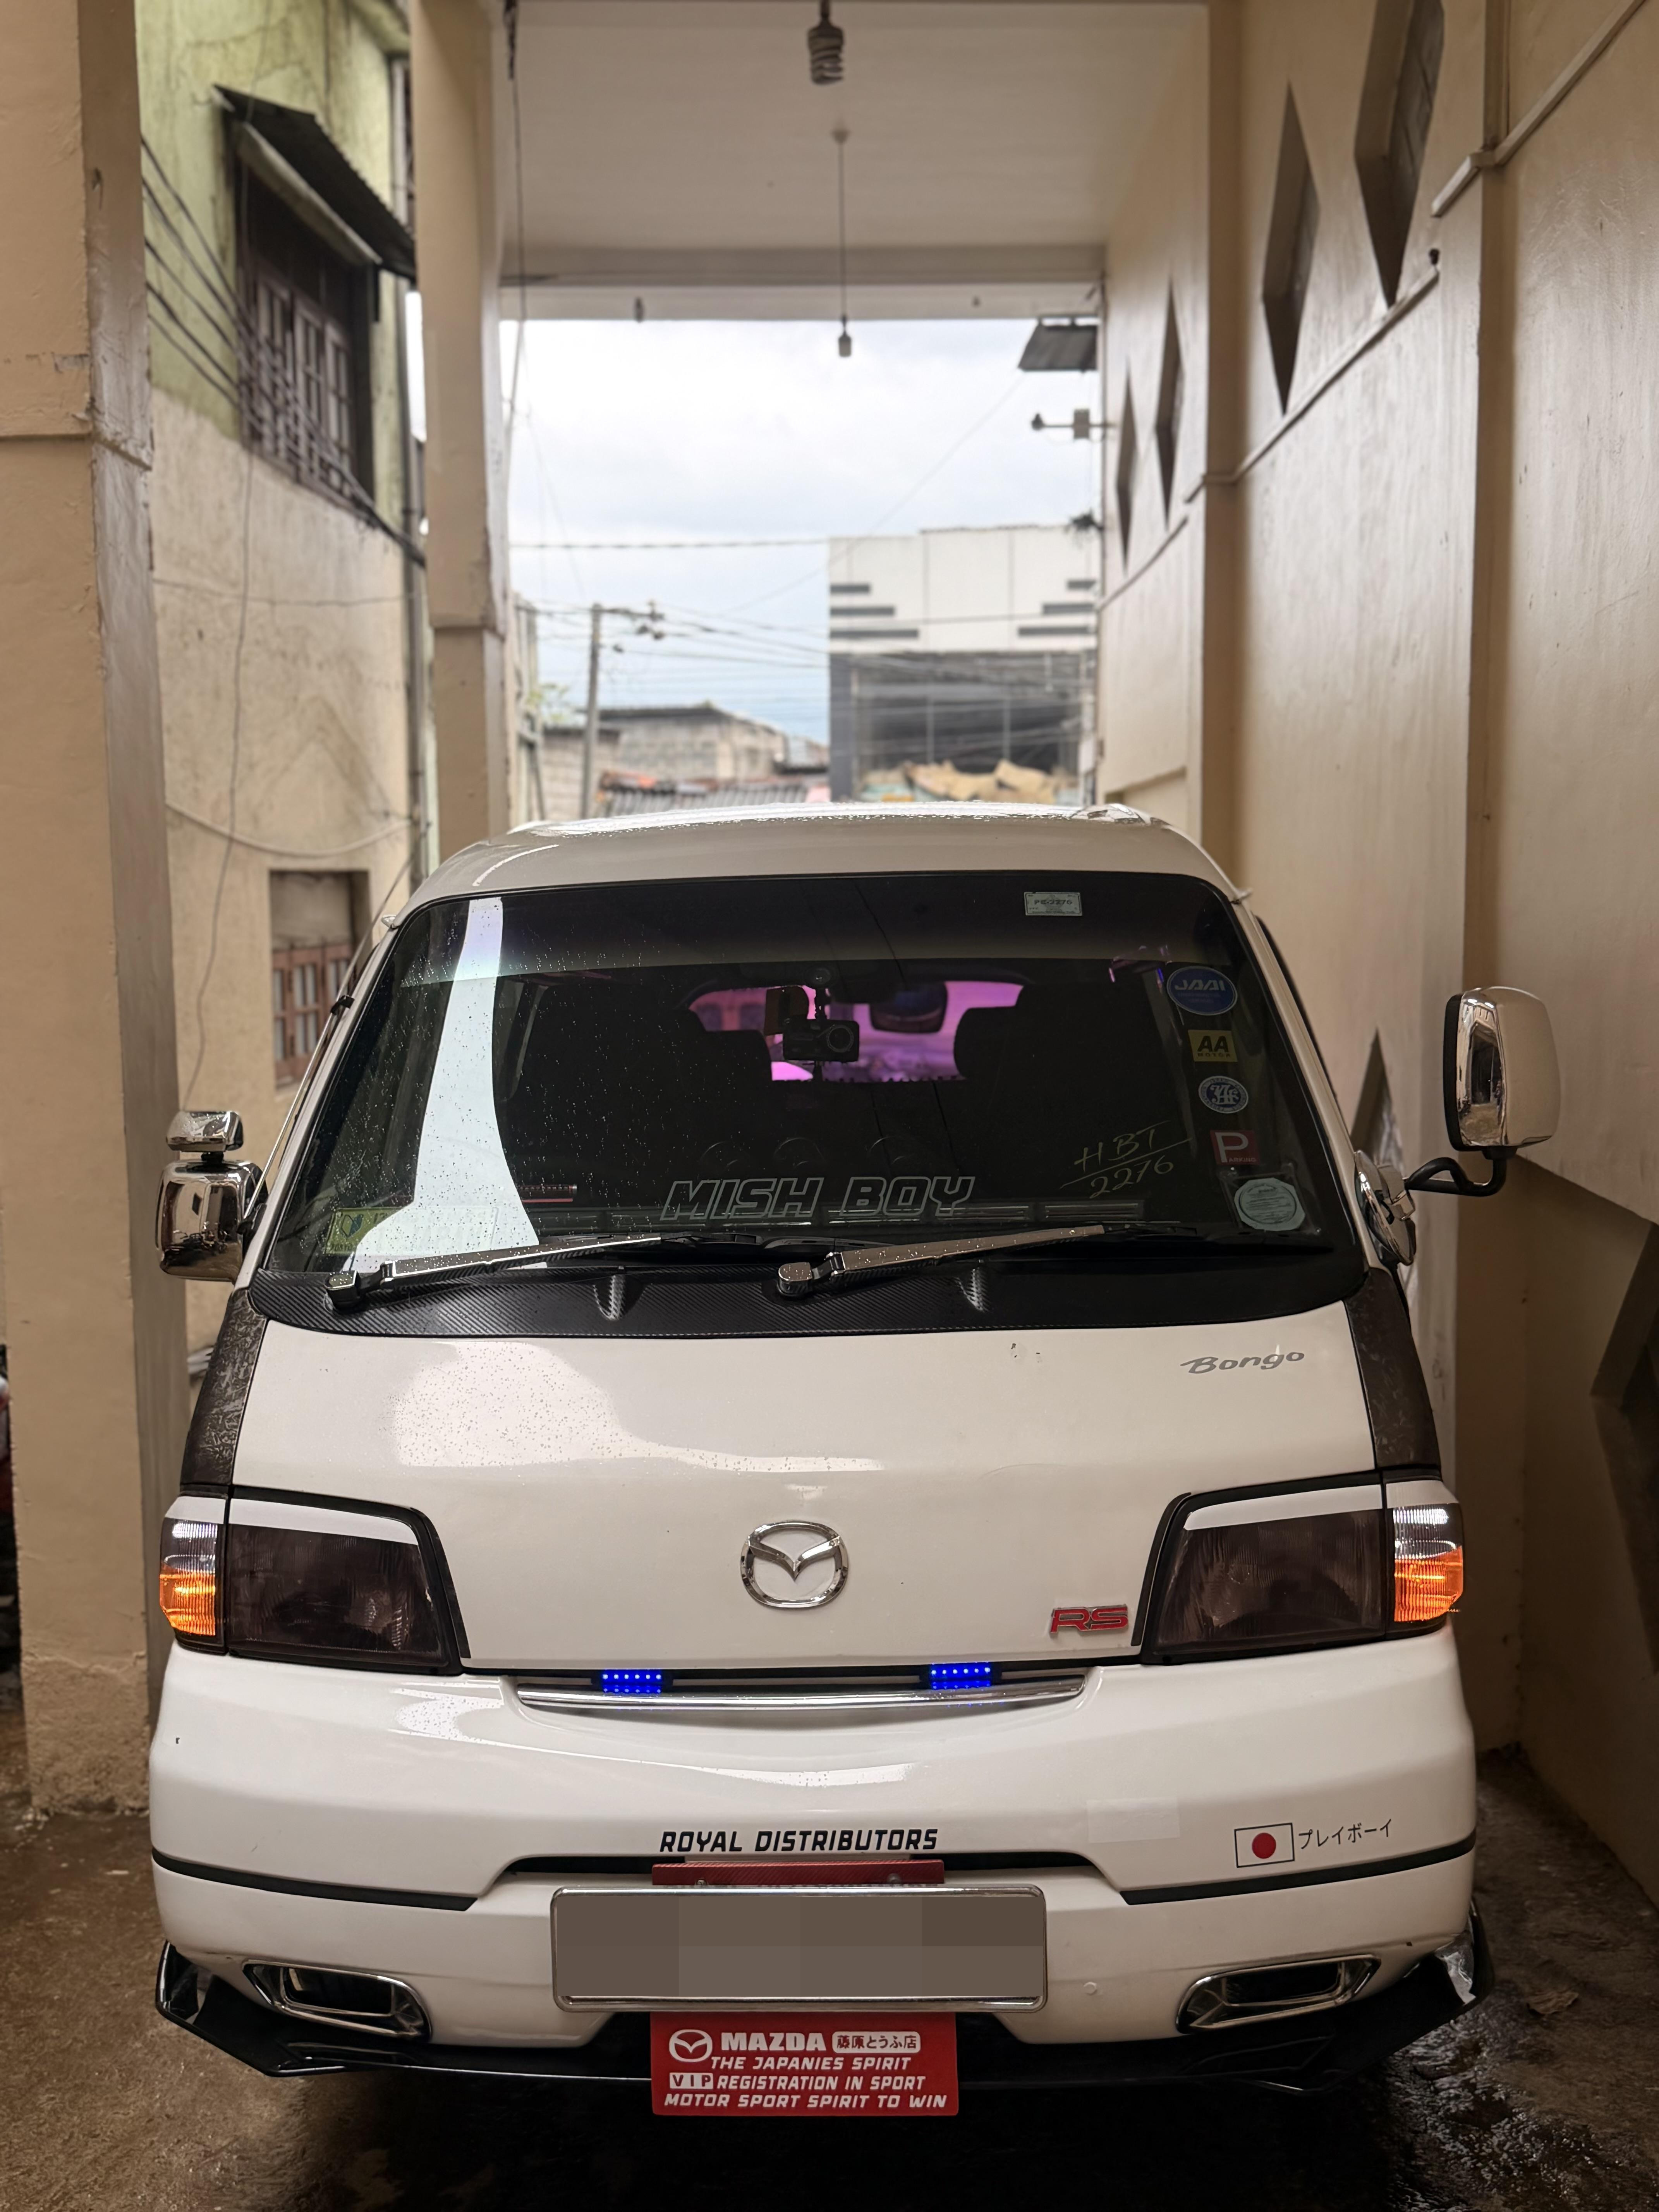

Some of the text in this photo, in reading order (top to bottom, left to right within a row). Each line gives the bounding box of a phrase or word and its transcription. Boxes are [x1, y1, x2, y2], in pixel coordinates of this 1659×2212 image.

[1174, 979, 1226, 991] JAAI
[1197, 1036, 1229, 1052] AA
[1089, 1155, 1174, 1199] 2276
[659, 1176, 975, 1221] MISH BOY
[1180, 1352, 1304, 1374] Bongo
[1049, 1604, 1128, 1633] RS
[660, 1829, 938, 1852] ROYAL DISTRIBUTORS
[1298, 1819, 1391, 1850] プレイボーイ
[721, 2033, 826, 2051] MAZDA
[711, 2057, 912, 2071] THE JAPANIES SPIRIT
[672, 2075, 926, 2090] VIP REGISTRATION IN SPORT
[664, 2094, 947, 2108] MOTOR SPORT SPIRIT TO WIN
